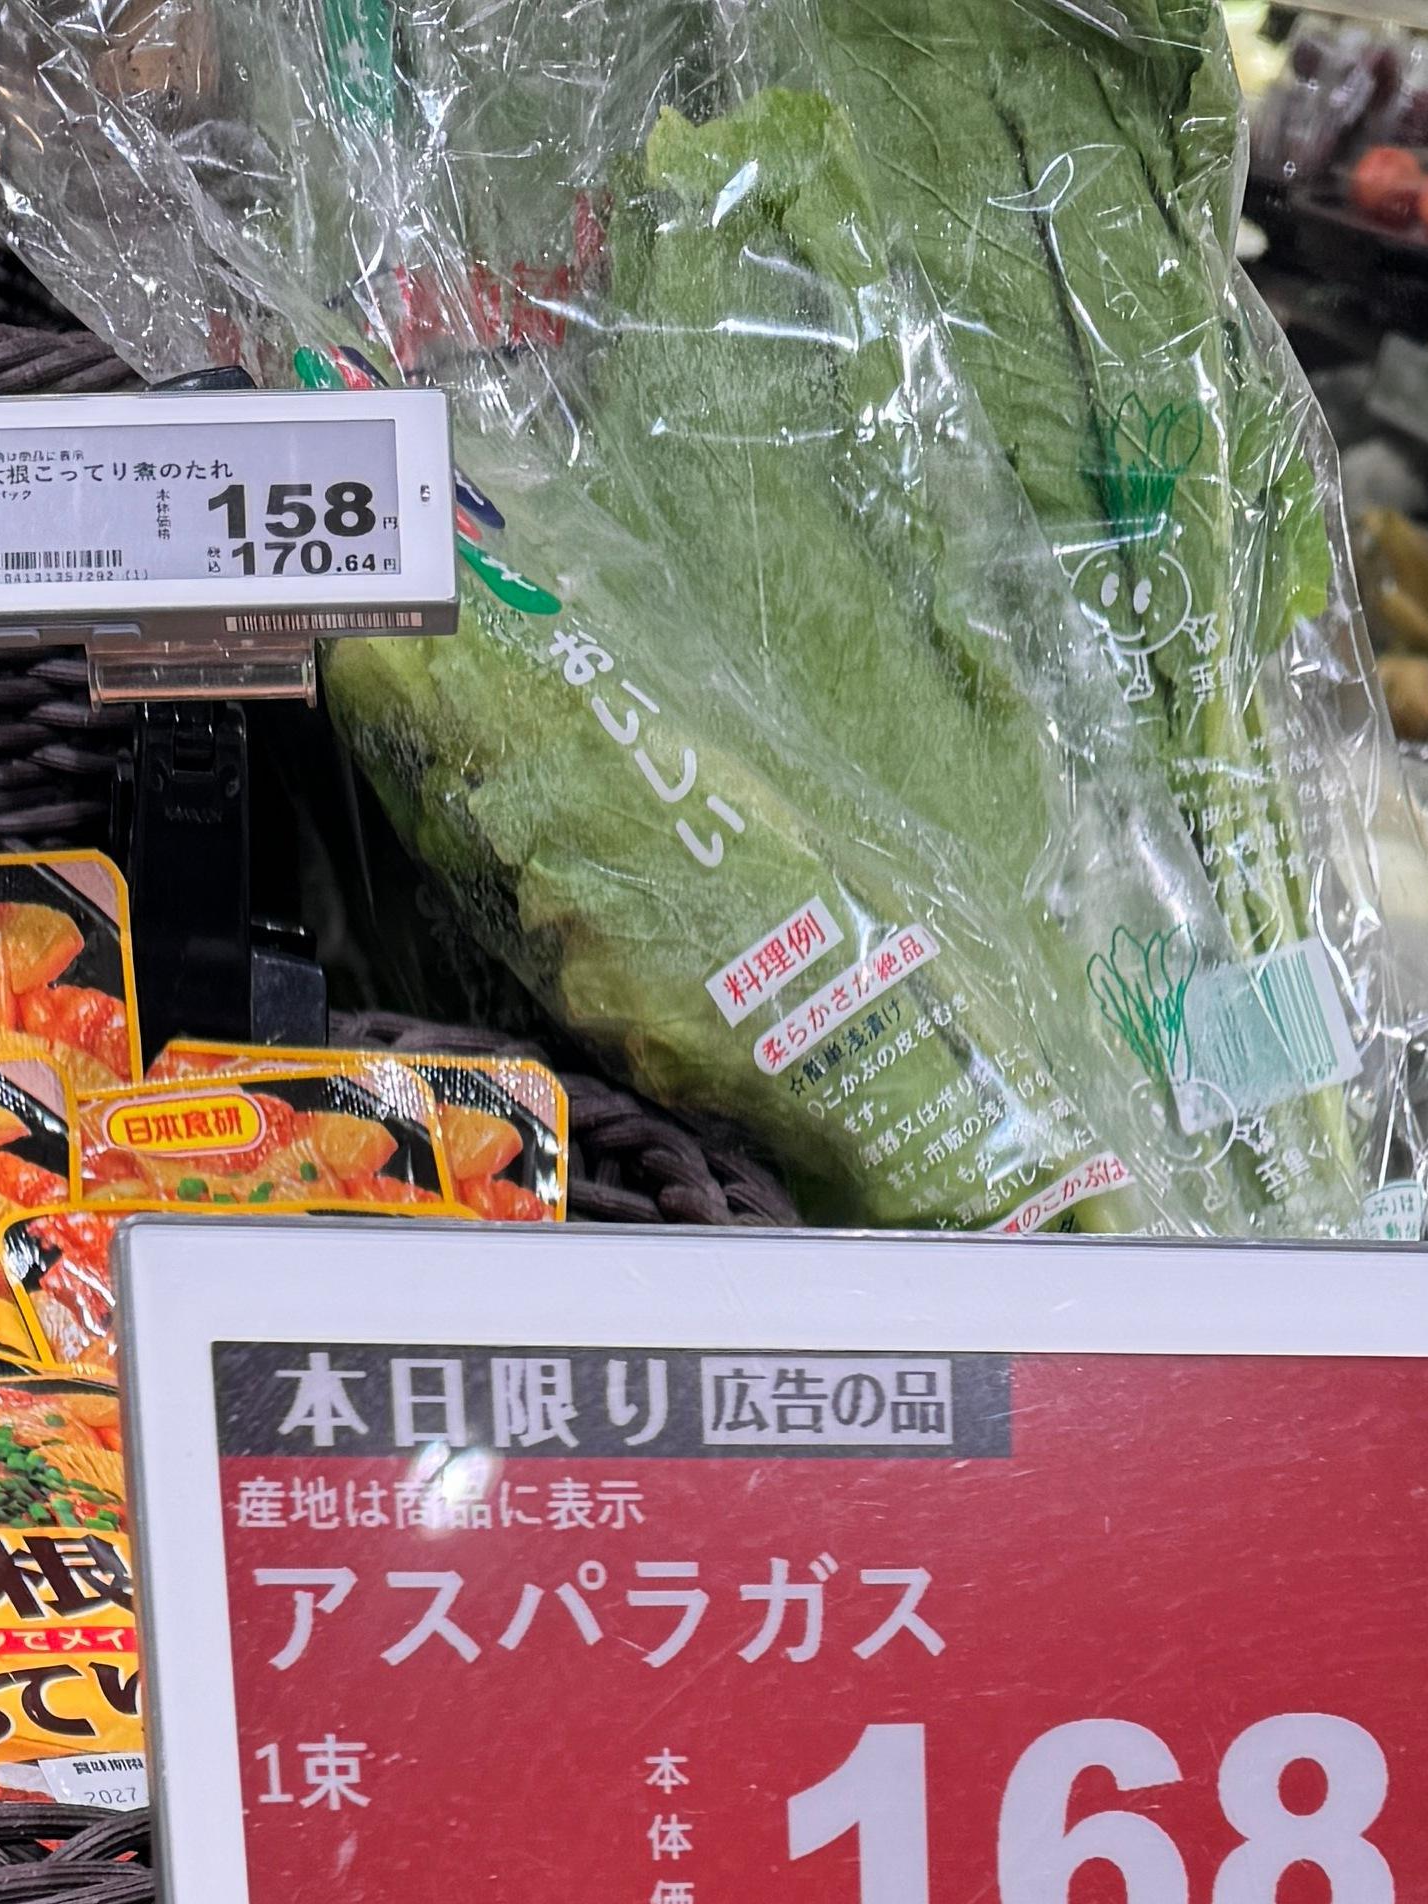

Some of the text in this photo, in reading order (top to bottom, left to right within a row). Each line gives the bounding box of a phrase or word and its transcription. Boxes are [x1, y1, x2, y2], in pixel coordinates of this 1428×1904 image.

[549, 628, 745, 868] おいしい
[722, 909, 827, 1008] 料理例
[124, 1106, 244, 1146] 日本食研
[276, 1352, 669, 1449] 本日限り
[710, 1366, 948, 1436] 広告の品
[237, 1478, 647, 1532] 産地は商品に表示
[252, 1557, 946, 1670] アスパラガス
[253, 1733, 371, 1811] 1束
